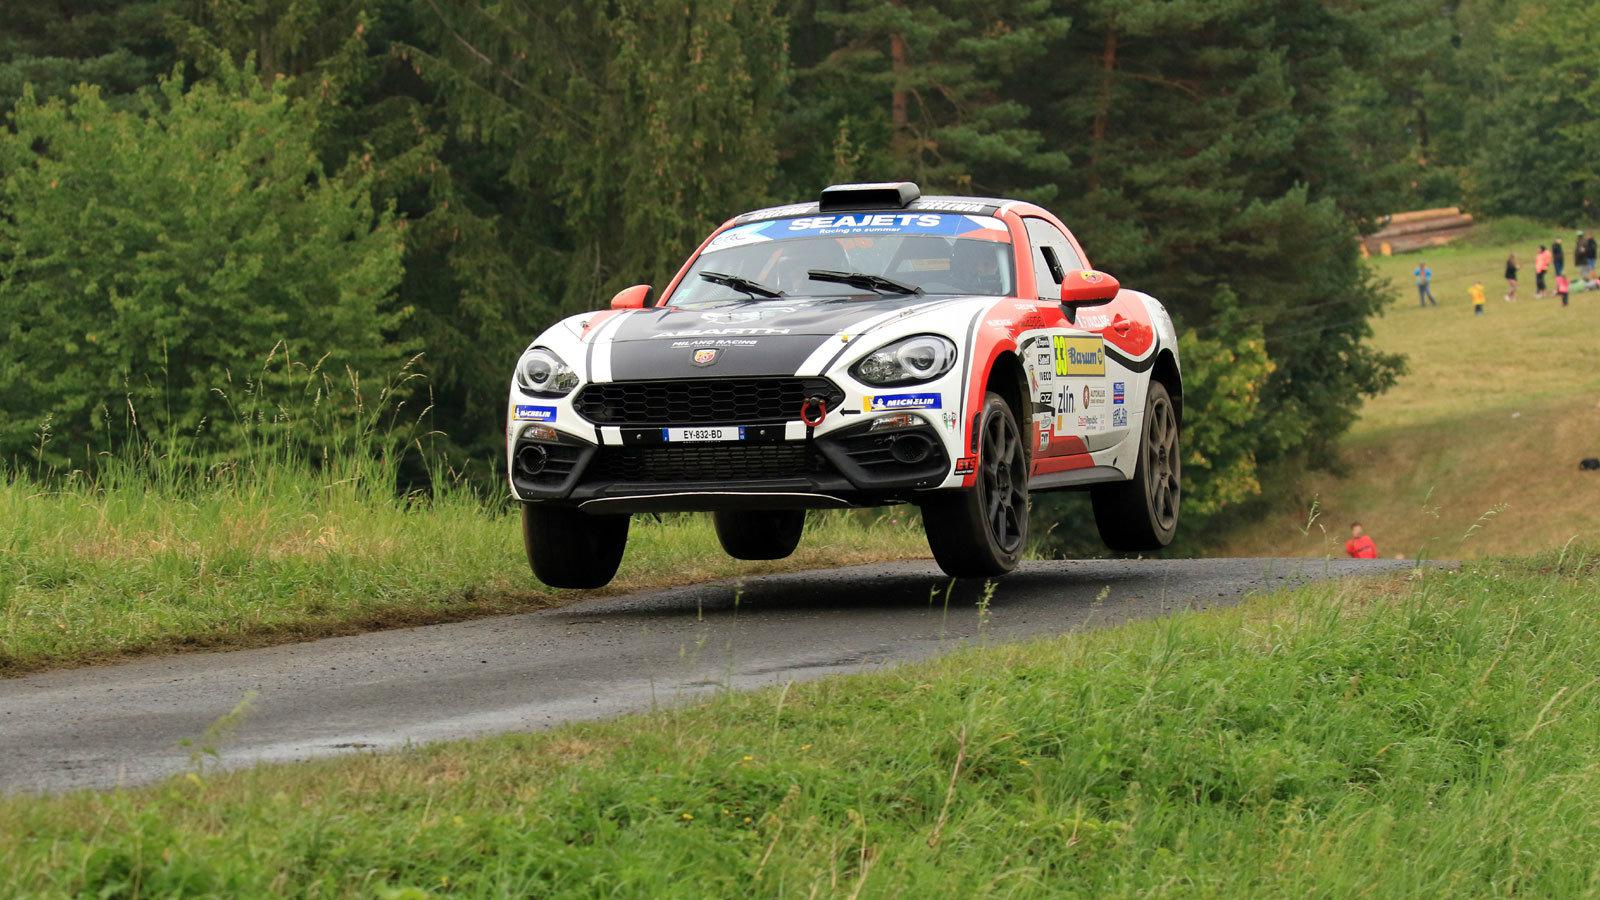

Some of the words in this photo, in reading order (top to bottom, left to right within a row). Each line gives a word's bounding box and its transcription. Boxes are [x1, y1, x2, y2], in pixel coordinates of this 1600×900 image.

[788, 213, 941, 232] SEAJETS
[650, 327, 791, 338] ABARTH
[1068, 347, 1097, 364] Barum
[1039, 371, 1052, 381] IVECO
[887, 398, 934, 406] MICHELIN
[1040, 393, 1052, 403] OZ
[1057, 384, 1075, 414] zlín
[519, 409, 552, 418] MICHELIN
[683, 430, 723, 440] EY-832-BD
